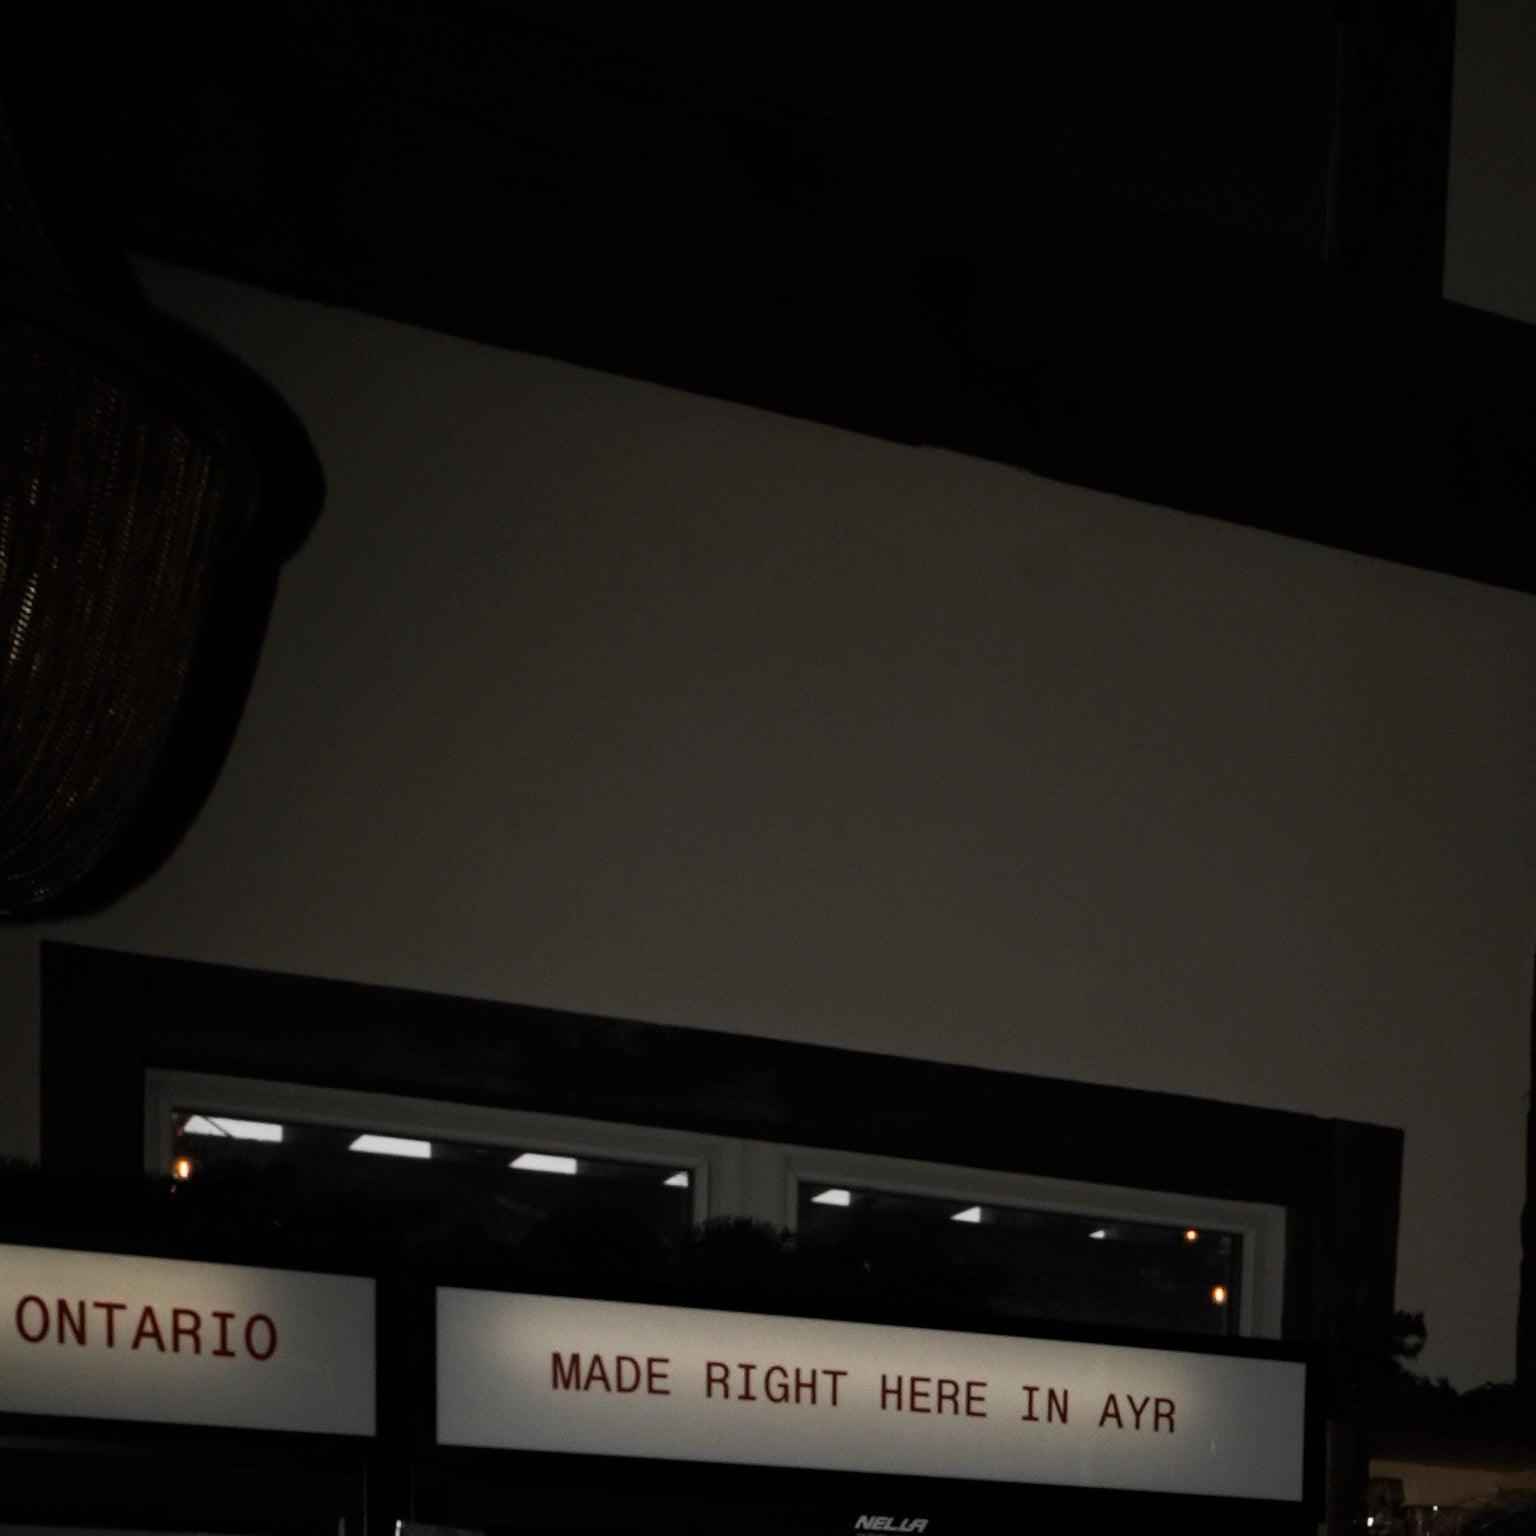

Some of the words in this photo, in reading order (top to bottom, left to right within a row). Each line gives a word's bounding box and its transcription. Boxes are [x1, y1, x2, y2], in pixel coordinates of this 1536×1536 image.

[15, 1295, 279, 1361] ONTARIO
[550, 1352, 671, 1396] MADE
[704, 1361, 848, 1407] RIGHT
[881, 1374, 988, 1418] HERE
[1021, 1386, 1069, 1425] IN
[1099, 1394, 1177, 1433] AYR
